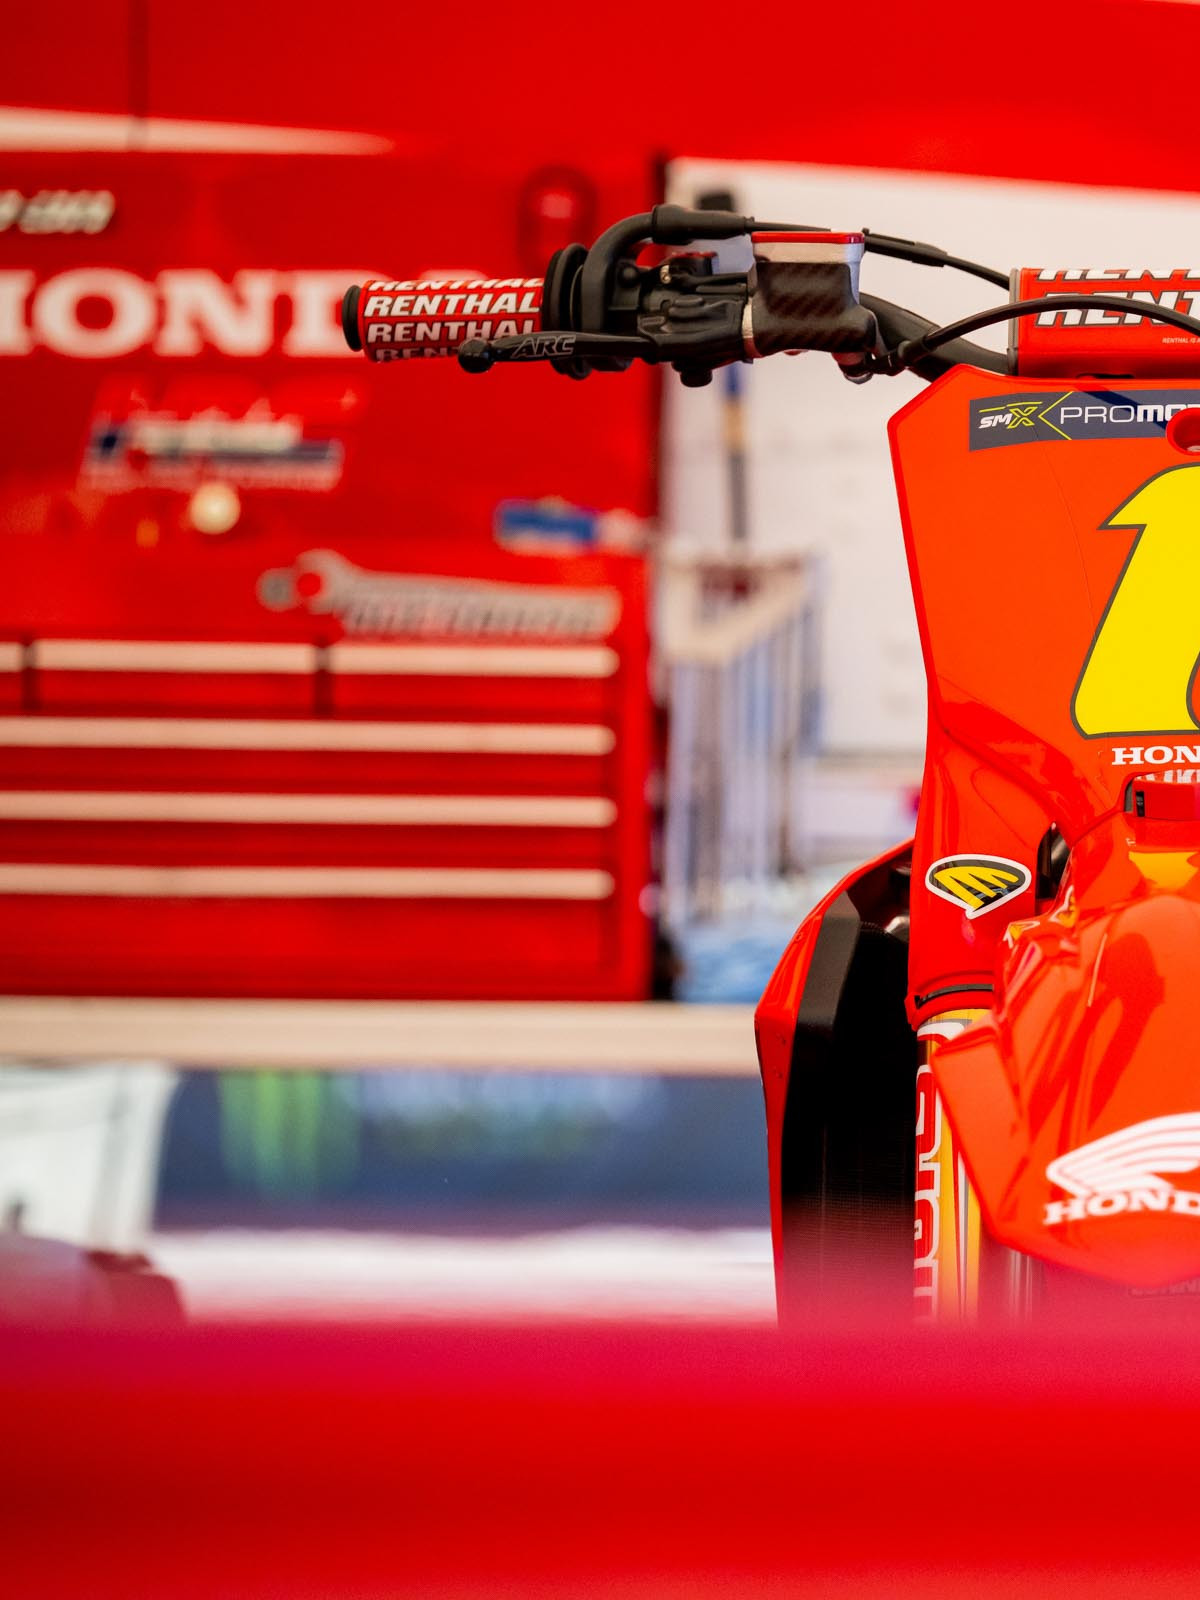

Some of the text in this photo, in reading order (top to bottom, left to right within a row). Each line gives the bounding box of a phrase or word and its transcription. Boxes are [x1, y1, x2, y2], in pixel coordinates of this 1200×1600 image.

[363, 292, 541, 318] RENTHAL
[511, 334, 577, 359] ARC
[978, 406, 1039, 430] SMX
